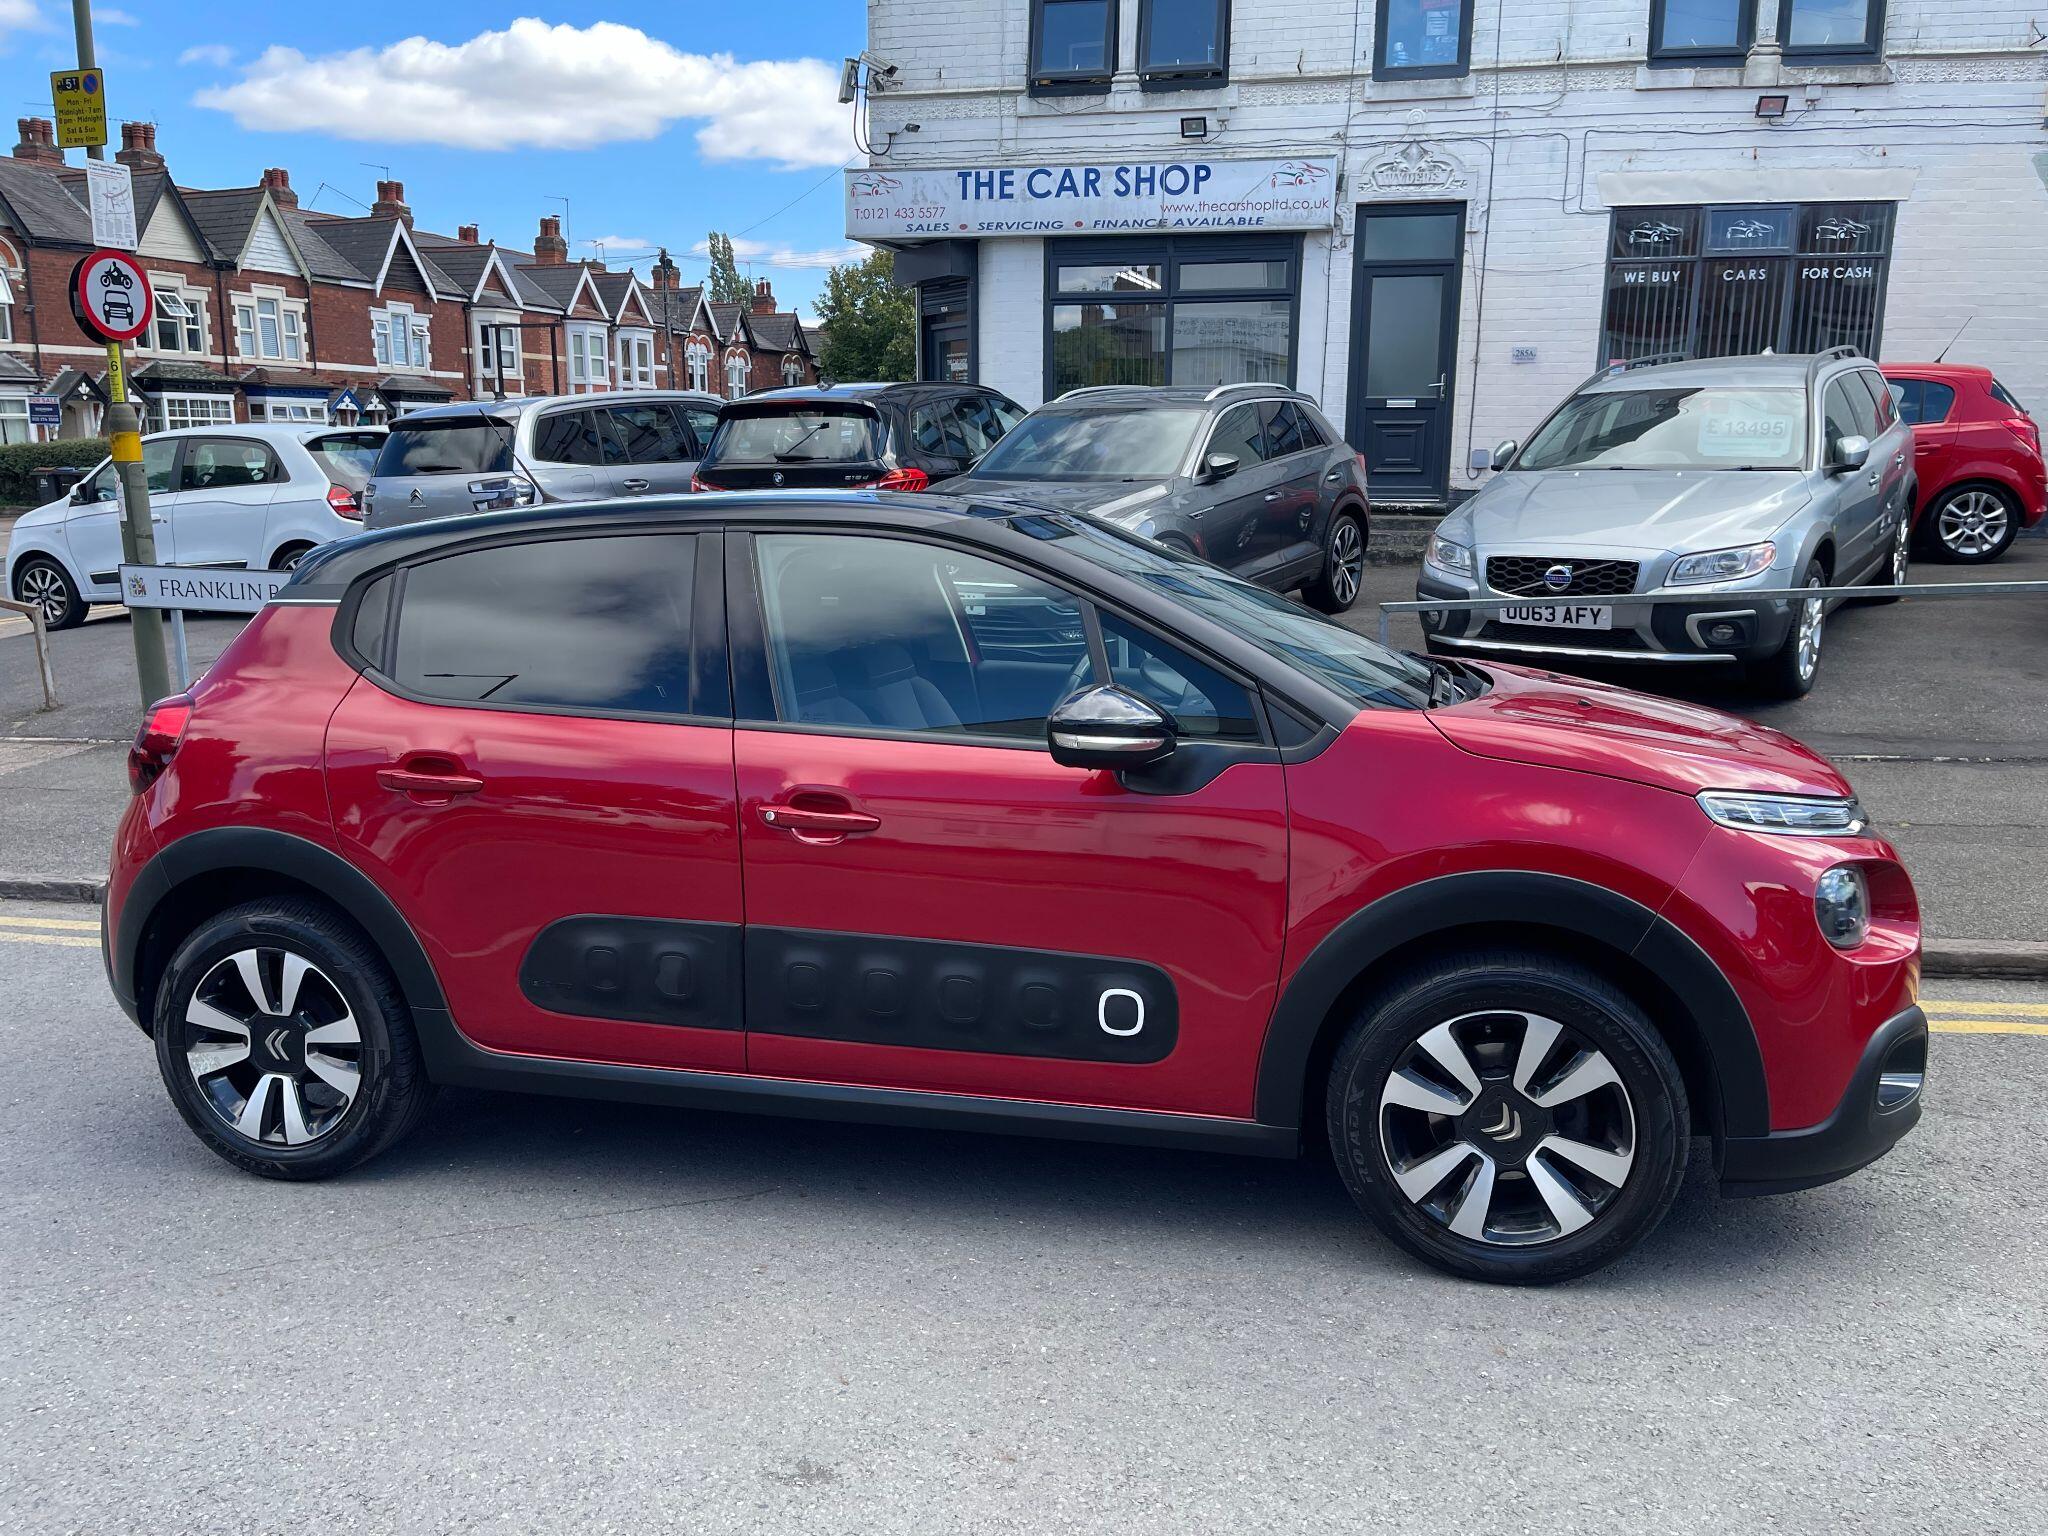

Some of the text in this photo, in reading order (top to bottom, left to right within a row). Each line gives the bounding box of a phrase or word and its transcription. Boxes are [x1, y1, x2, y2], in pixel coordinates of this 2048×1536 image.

[78, 115, 102, 123] Midnight
[957, 164, 1212, 201] THE CAR SHOP
[854, 206, 946, 220] T:0121 433 5577
[1160, 197, 1330, 214] www.thecarshopltd.co.uk
[905, 216, 1265, 233] SALES SERVICING FINANCE AVAILABLE
[1624, 266, 1873, 283] WE BUY CARS FOR CASH
[110, 360, 119, 372] 6
[1705, 419, 1785, 436] £ 13495
[159, 579, 262, 600] FRANKLIN
[1562, 607, 1602, 626] AFY
